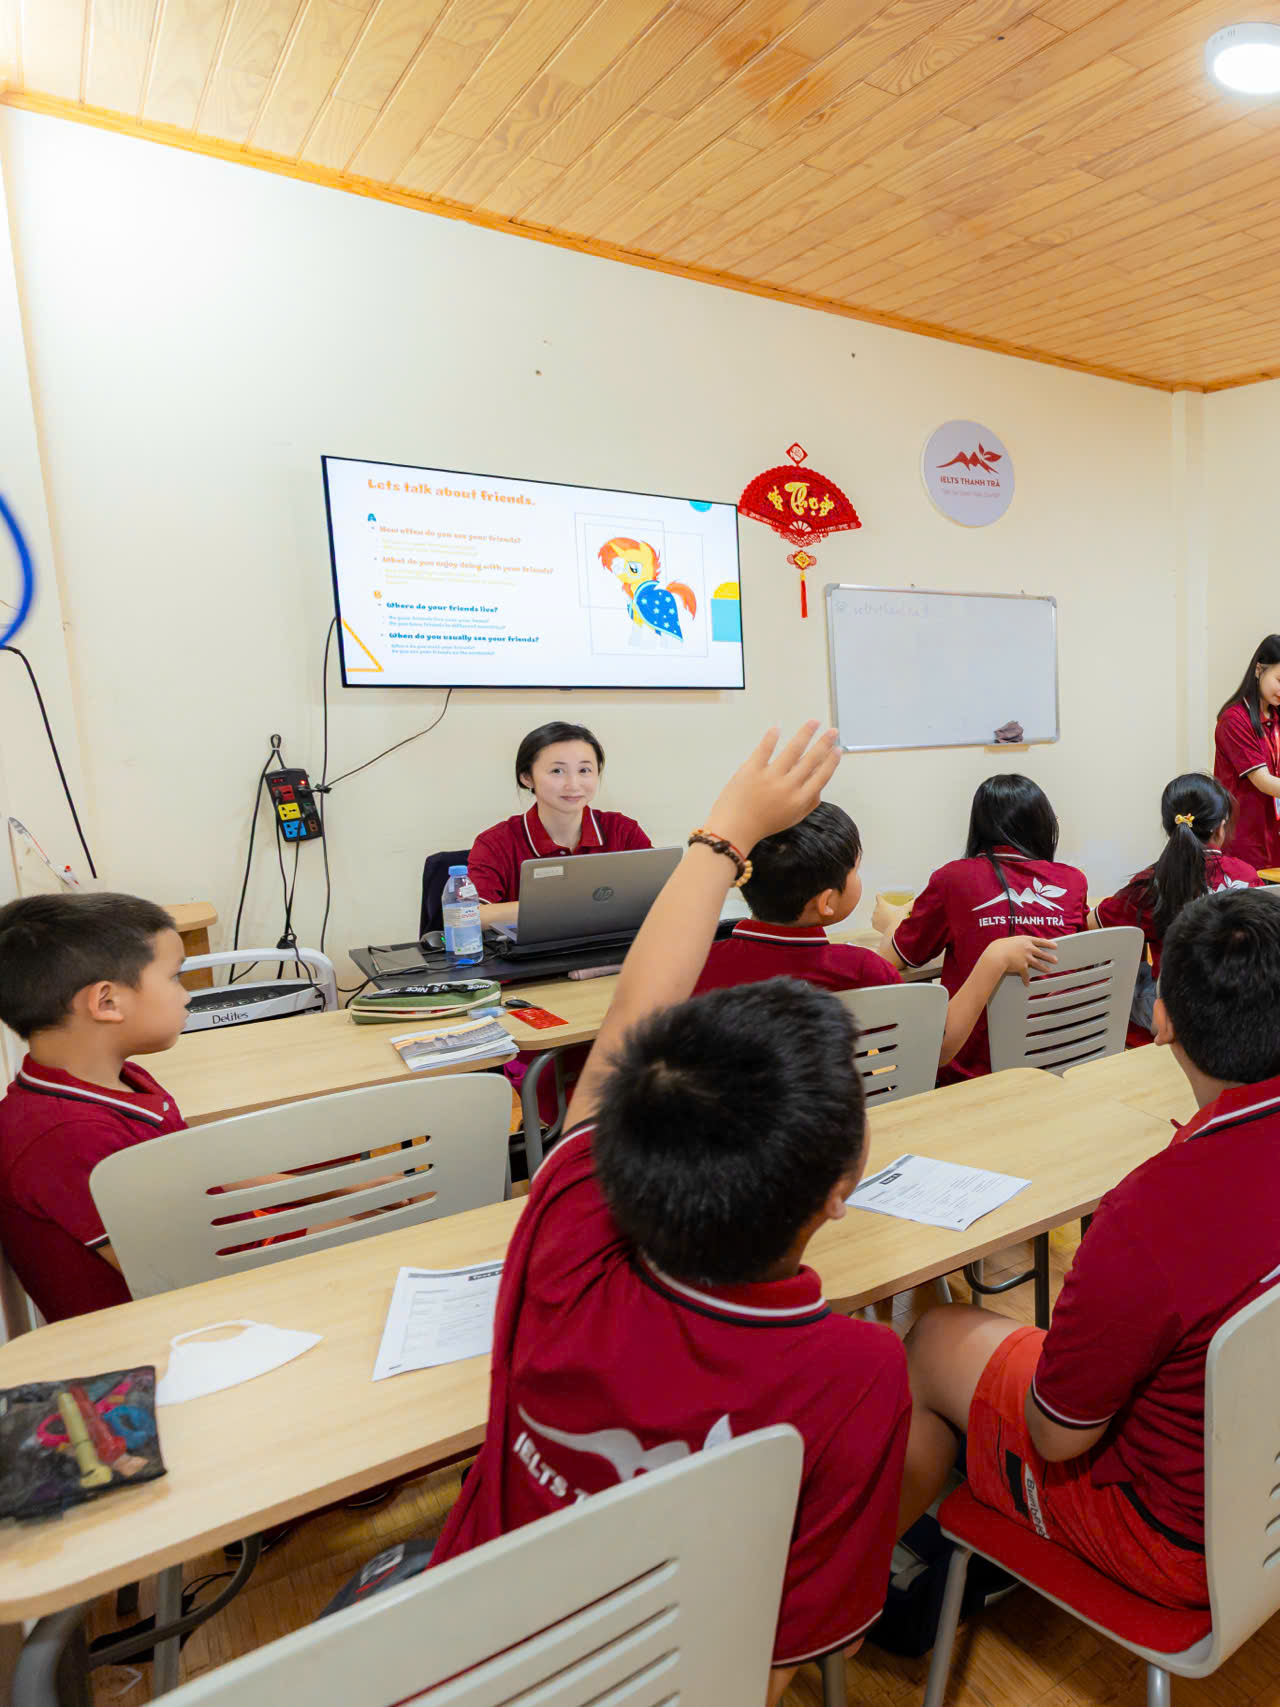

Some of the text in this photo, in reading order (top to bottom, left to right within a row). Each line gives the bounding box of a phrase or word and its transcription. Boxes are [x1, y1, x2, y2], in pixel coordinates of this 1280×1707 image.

[940, 475, 959, 484] IELTS
[960, 477, 986, 487] THANH
[404, 482, 432, 495] talk
[436, 487, 477, 500] about
[481, 490, 536, 506] friends.
[367, 513, 377, 522] A
[386, 602, 414, 610] Where
[427, 604, 448, 612] your
[480, 605, 499, 613] live?
[389, 632, 413, 640] When
[426, 634, 442, 642] you
[443, 633, 472, 643] usually
[488, 635, 506, 643] your
[507, 635, 540, 643] friends?
[978, 914, 1065, 927] IELTS THANH TRÀ
[513, 1431, 569, 1498] IELTS
